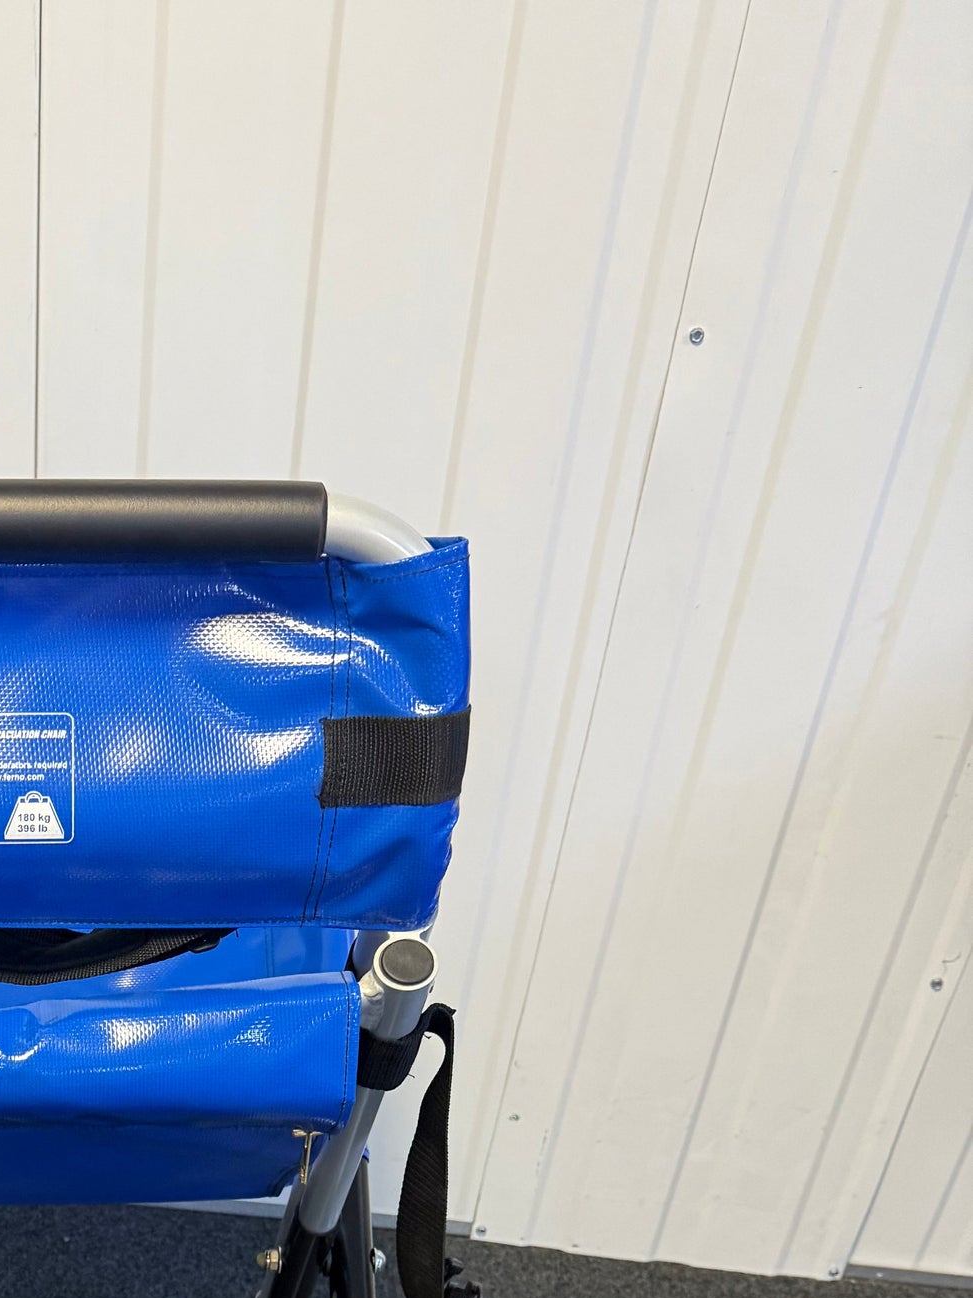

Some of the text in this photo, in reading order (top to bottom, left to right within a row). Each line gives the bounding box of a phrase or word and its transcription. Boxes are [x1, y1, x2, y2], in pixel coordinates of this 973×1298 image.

[41, 730, 67, 739] CHAIR
[33, 761, 68, 772] required
[17, 813, 51, 824] 180 kg
[17, 824, 48, 833] 396 lb
